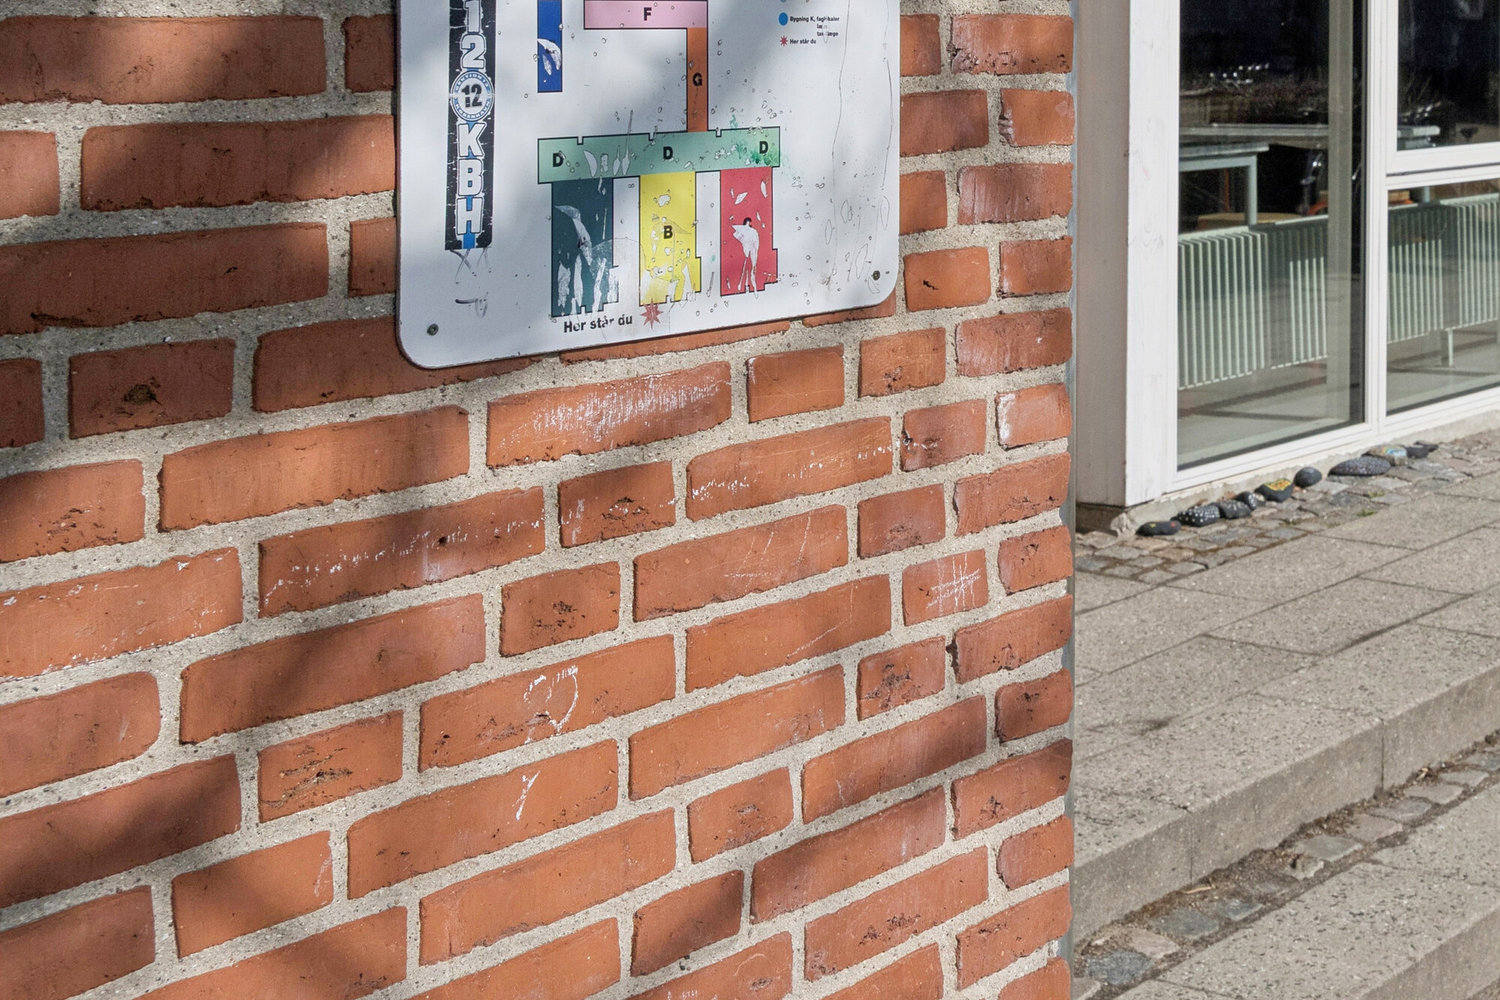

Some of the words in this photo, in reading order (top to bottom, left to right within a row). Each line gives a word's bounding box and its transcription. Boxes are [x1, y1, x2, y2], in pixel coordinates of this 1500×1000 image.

[644, 7, 652, 22] F
[693, 73, 702, 86] G
[663, 146, 673, 160] D
[759, 141, 768, 154] D
[553, 153, 564, 168] D
[663, 226, 673, 239] B
[618, 314, 632, 326] du
